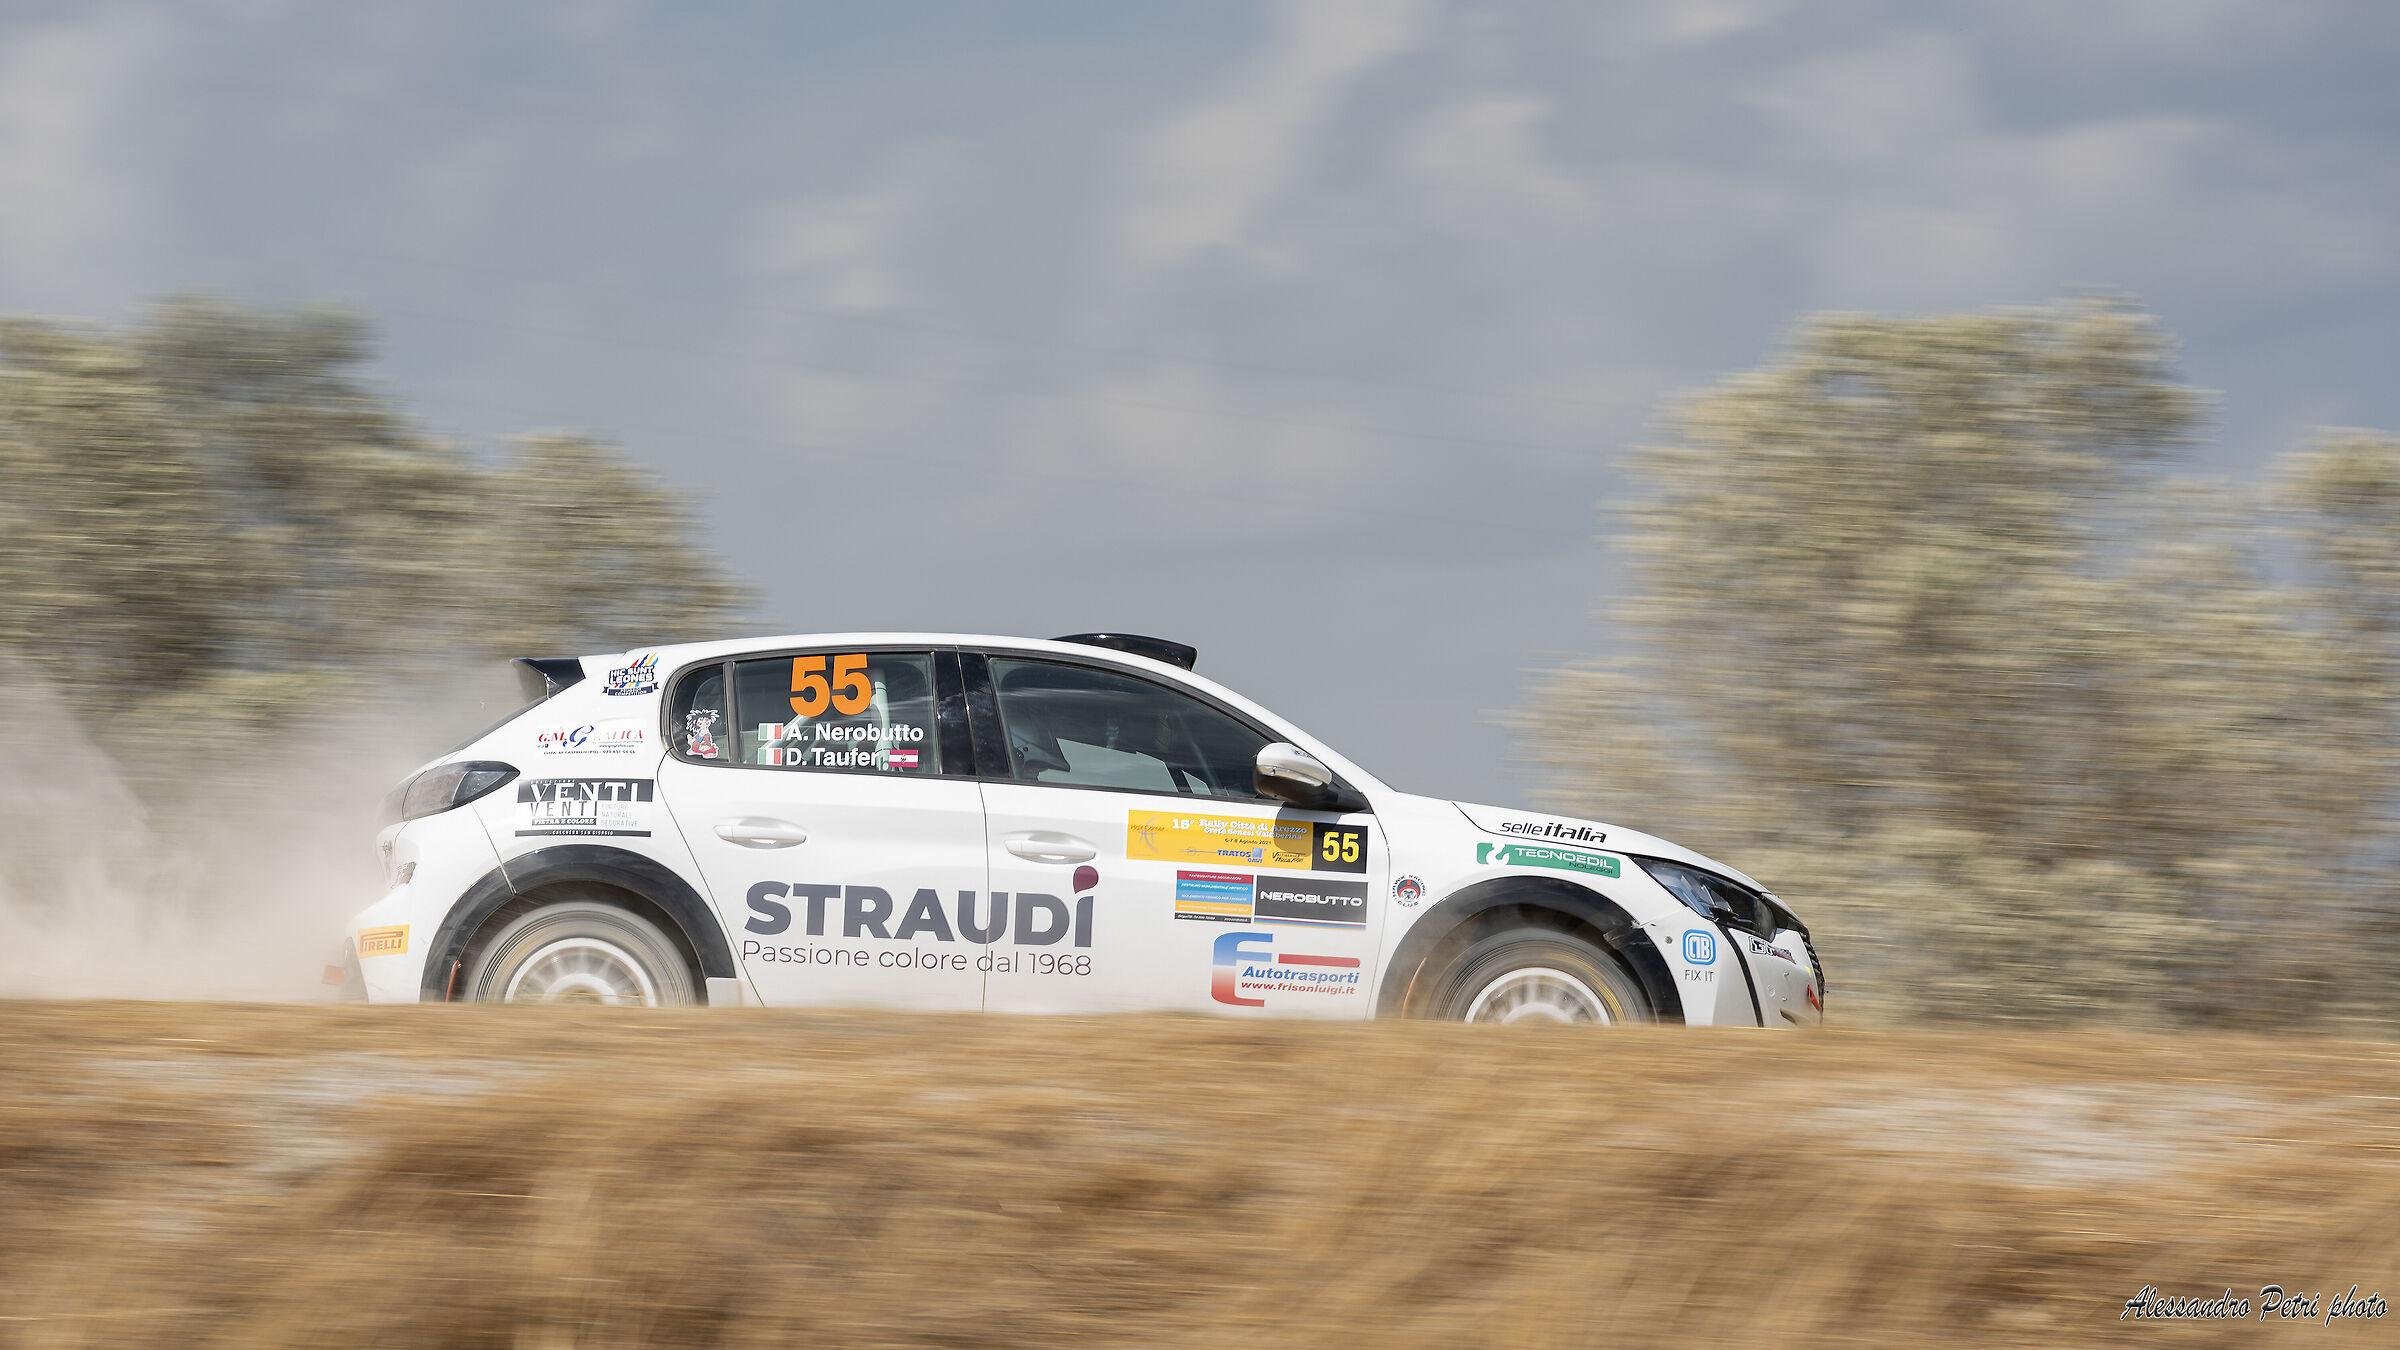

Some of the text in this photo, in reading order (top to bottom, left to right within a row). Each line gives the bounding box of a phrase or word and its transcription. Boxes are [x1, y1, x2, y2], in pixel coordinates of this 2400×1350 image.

[610, 673, 653, 684] LEONES
[789, 653, 872, 717] 55
[786, 723, 924, 741] A. Nerobutto
[786, 748, 880, 766] D. Taufer
[530, 782, 639, 801] VENTI
[530, 801, 598, 816] VENTI
[1199, 818, 1229, 830] Rally
[1257, 821, 1269, 831] di
[1270, 824, 1309, 834] Arezzo
[1217, 849, 1252, 858] TRATOS
[1322, 831, 1360, 863] 55
[1515, 848, 1614, 869] TECNOEDIL
[1260, 890, 1363, 907] NEROBUTTO
[360, 931, 404, 953] PIRELLI
[742, 940, 1092, 976] Passione colore dal 1968
[1242, 966, 1360, 984] Autotrasporti
[1685, 969, 1714, 982] FIX IT
[1241, 981, 1356, 996] www.frisonluigi.it
